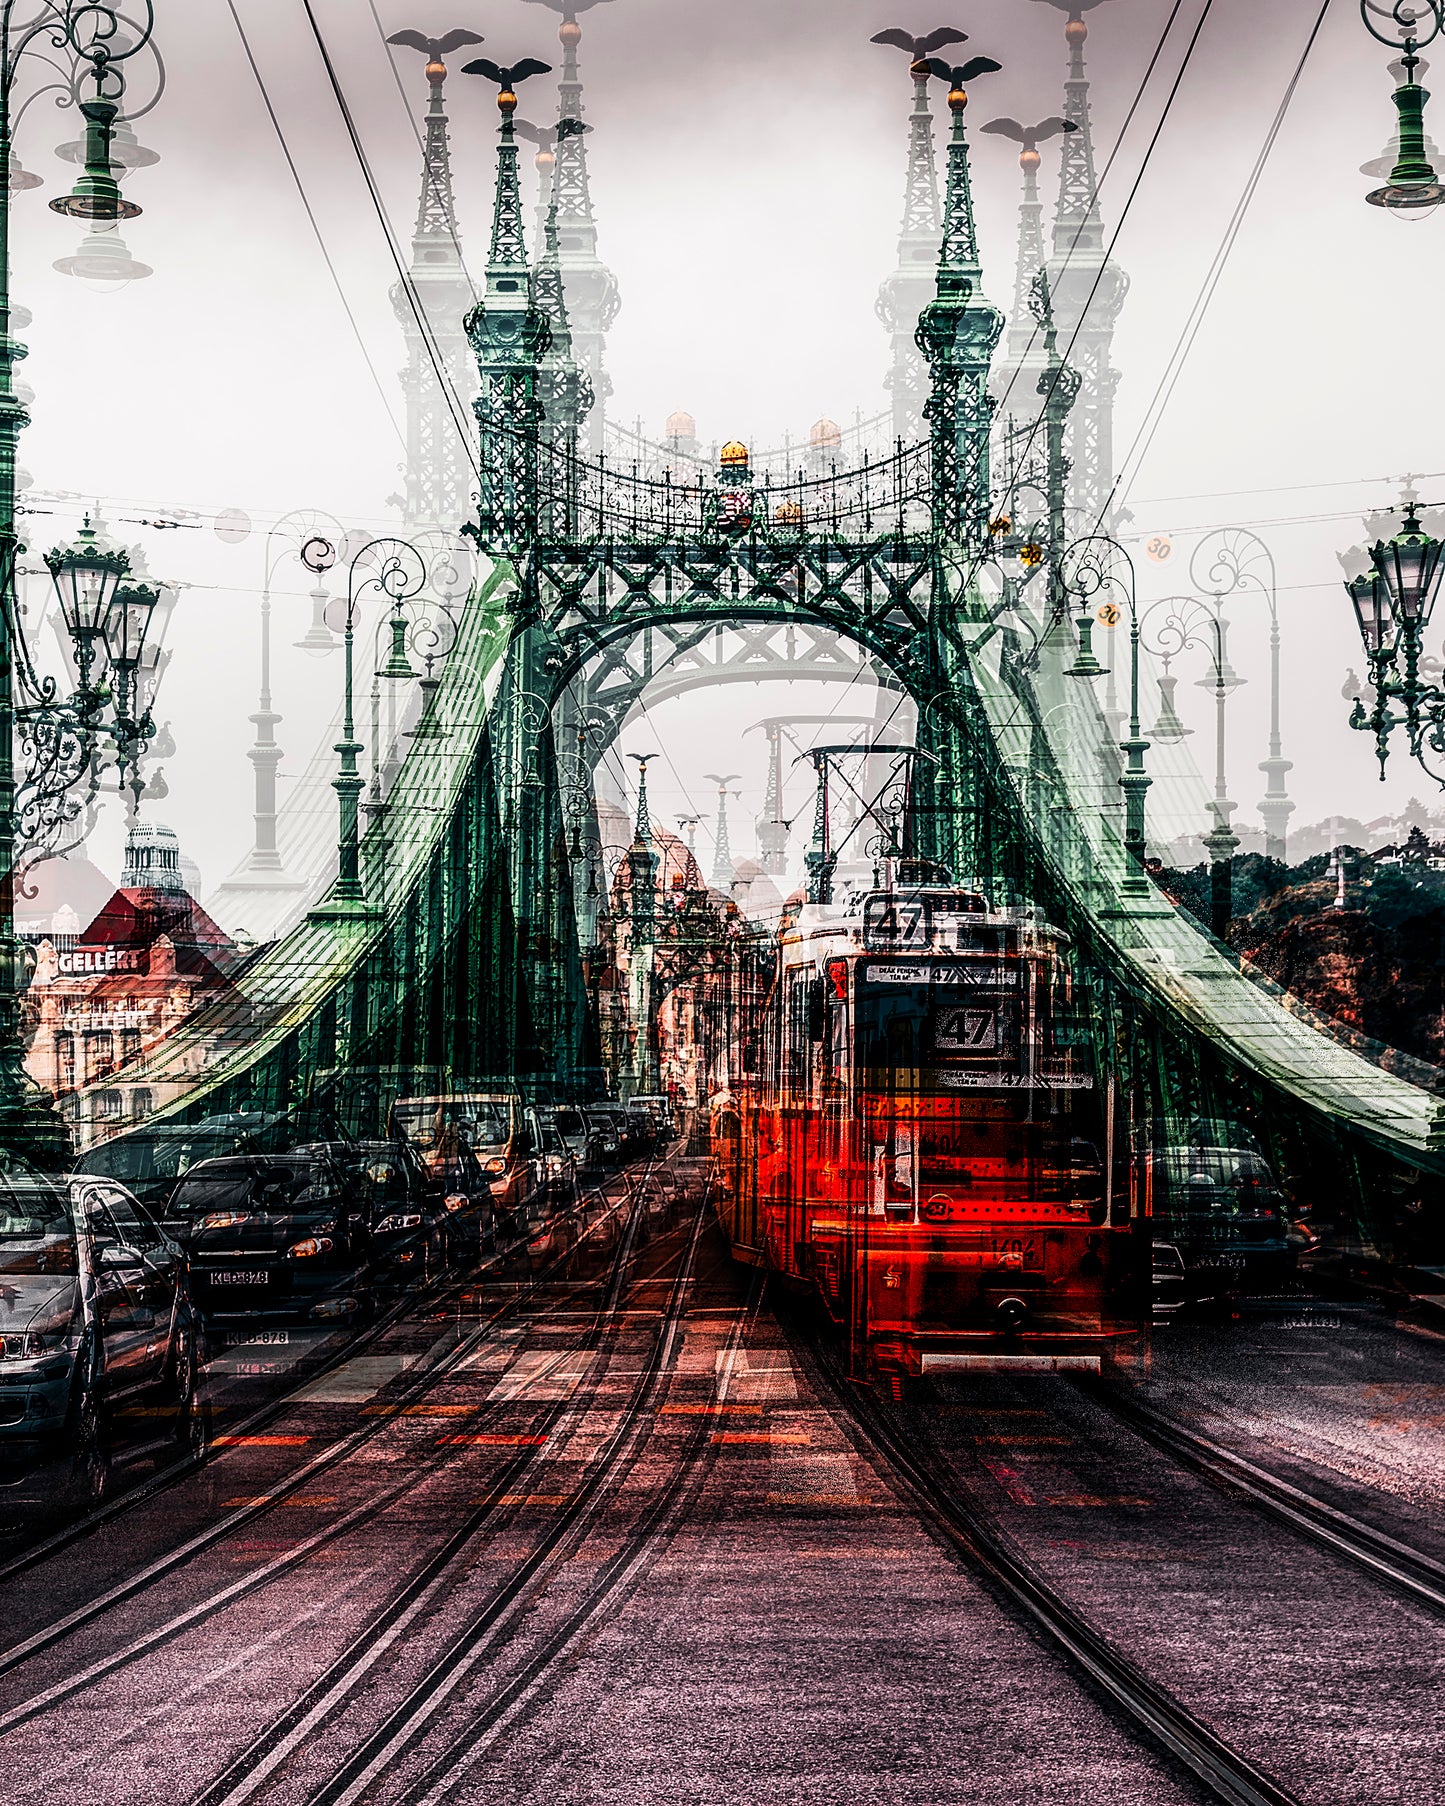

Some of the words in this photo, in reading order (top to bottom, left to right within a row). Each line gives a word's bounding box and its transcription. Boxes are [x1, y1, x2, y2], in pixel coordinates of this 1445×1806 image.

[1020, 545, 1042, 564] 30
[1148, 538, 1171, 559] 30
[1099, 605, 1121, 625] 30
[875, 907, 922, 941] 47
[58, 945, 145, 972] GELLÉRT
[931, 968, 953, 982] 47
[941, 1012, 992, 1044] 47
[1001, 1072, 1024, 1087] 47
[212, 1271, 268, 1284] KLD-878
[228, 1332, 287, 1344] KLD-878
